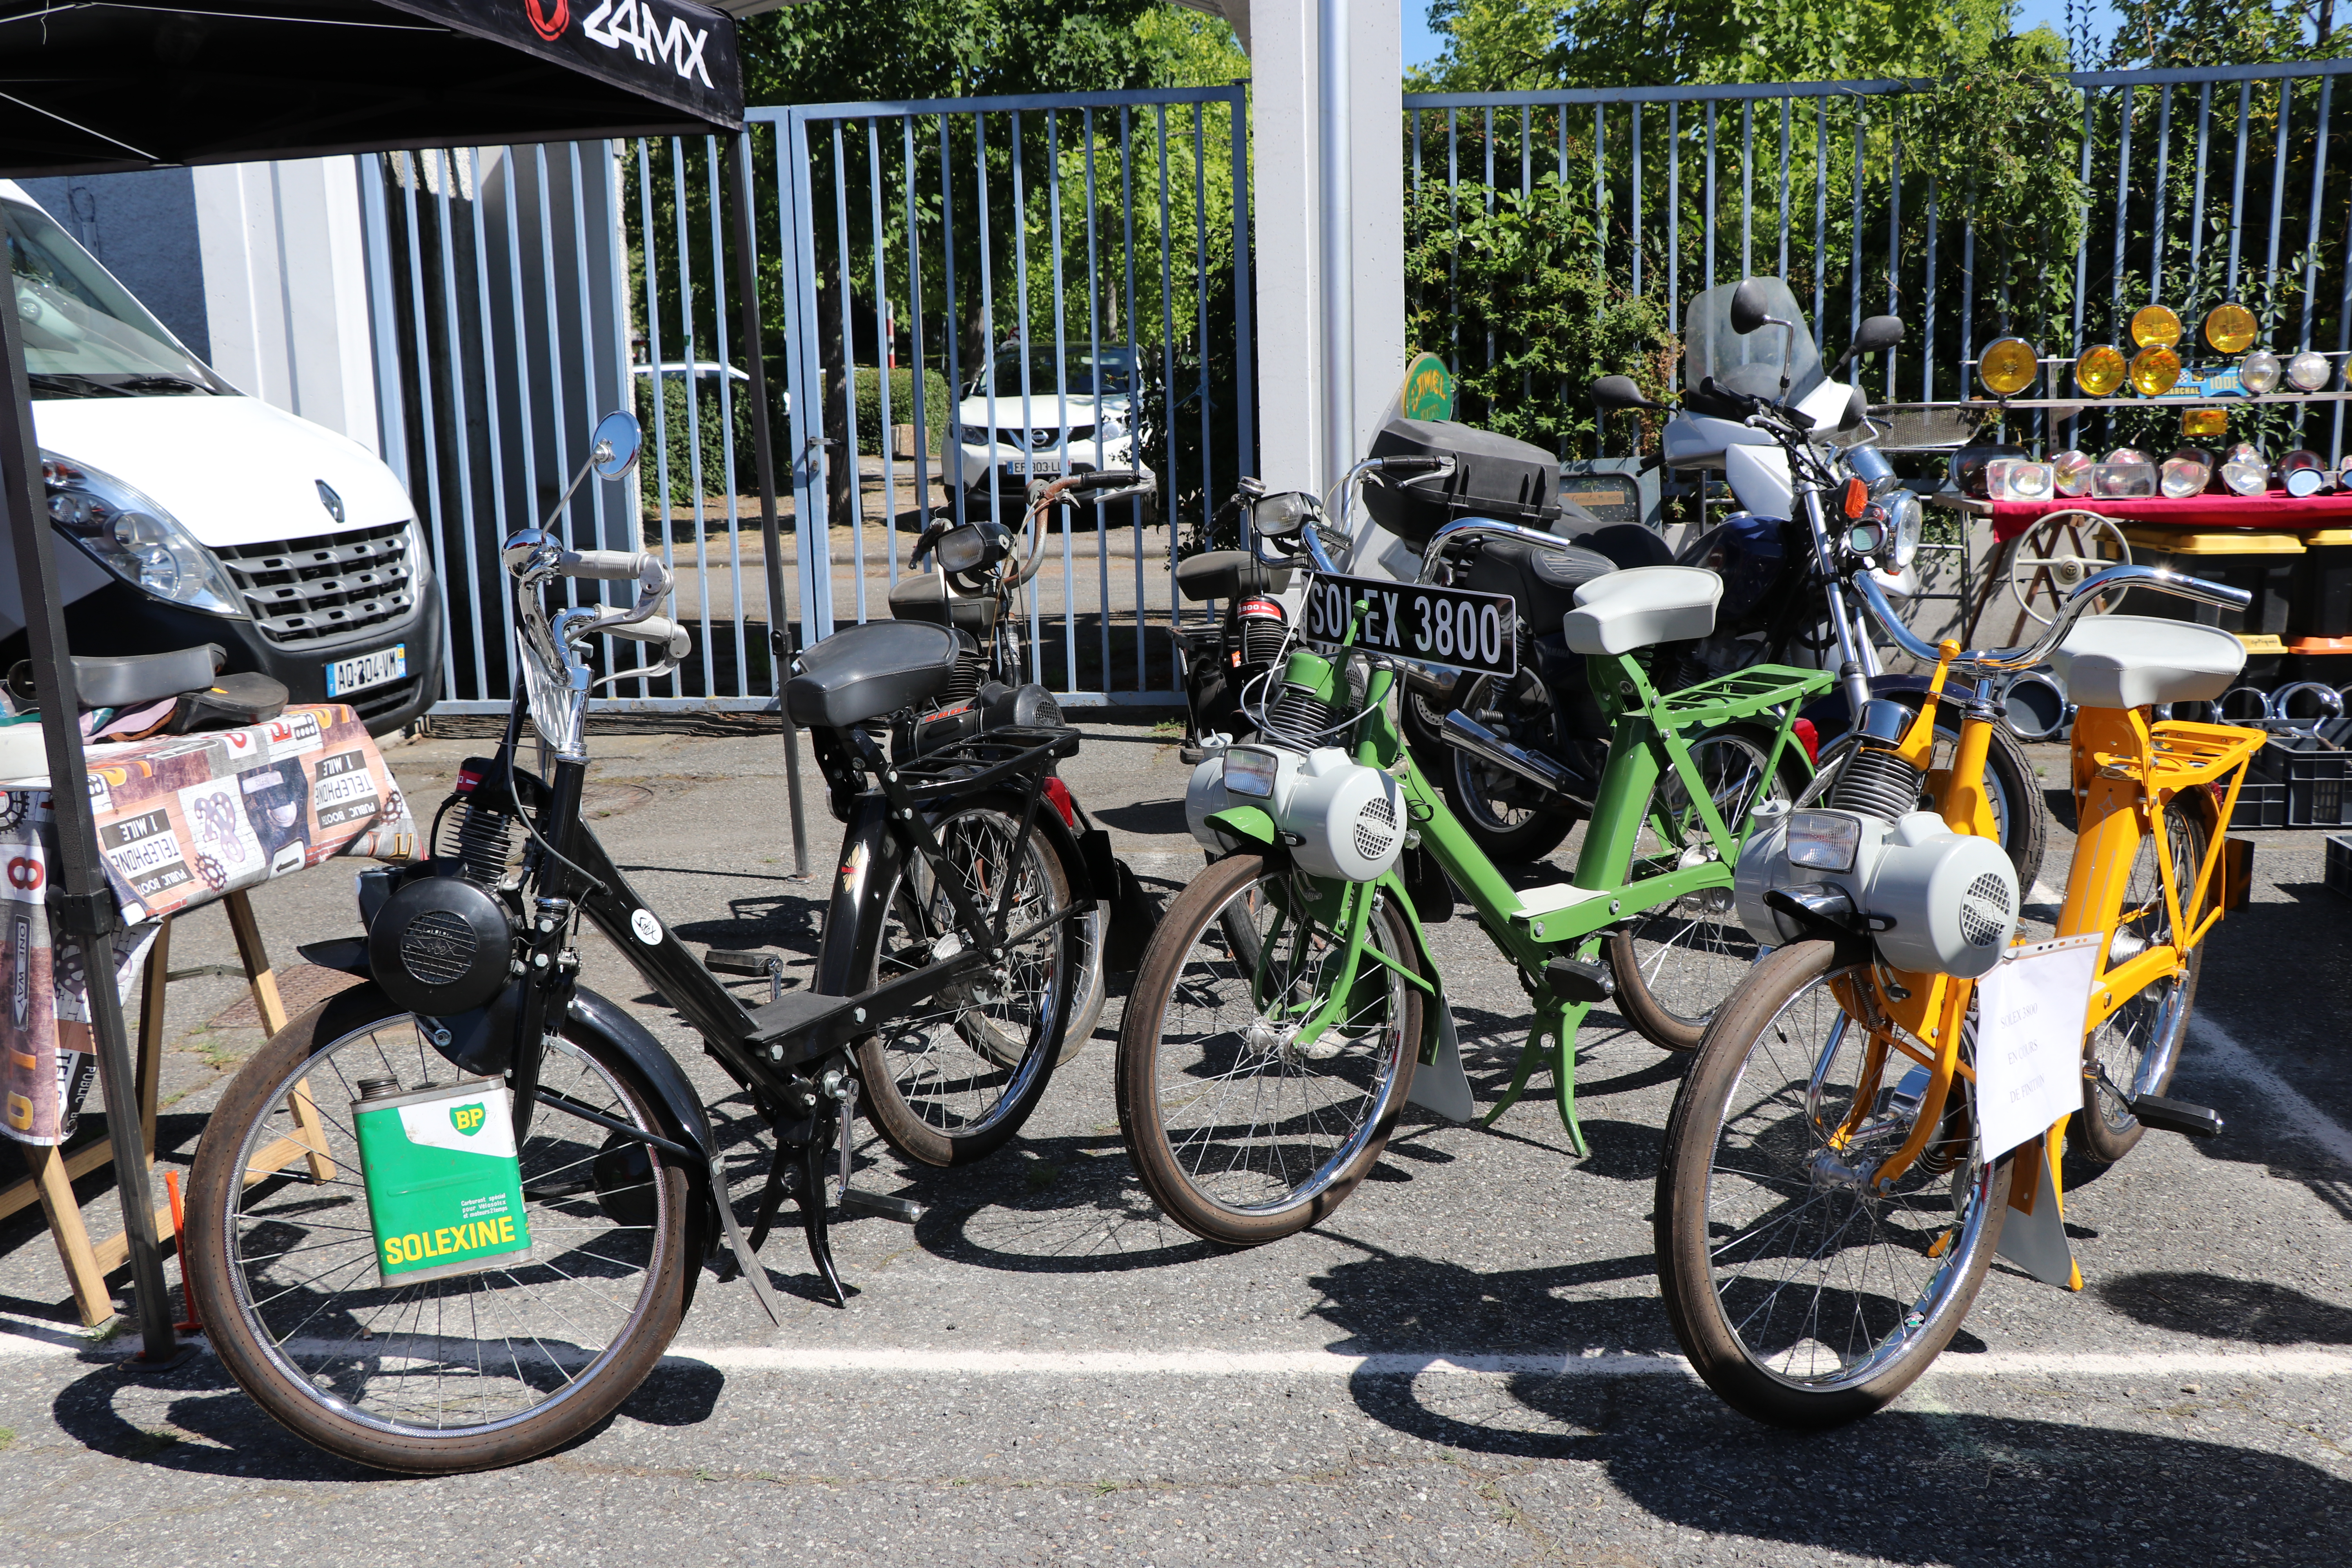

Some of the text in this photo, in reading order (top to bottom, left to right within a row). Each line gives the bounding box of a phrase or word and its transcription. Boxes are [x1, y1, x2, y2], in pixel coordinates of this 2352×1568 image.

[583, 0, 715, 89] 24MX
[1412, 369, 1447, 412] CAMEL
[2210, 376, 2239, 390] IODE
[1310, 581, 1502, 664] SOLEX 3800
[323, 757, 343, 777] MILE
[316, 774, 373, 805] TELEPHONE
[348, 802, 376, 817] PUBLIC
[119, 818, 148, 841] MILE
[161, 869, 188, 886] PUBLIC
[633, 917, 658, 942] Solex
[2001, 1002, 2038, 1029] SOLEX 3800
[2008, 1039, 2038, 1065] EN COURS
[76, 1066, 97, 1103] PUBLIC
[2009, 1073, 2045, 1103] DE FINITION
[454, 1108, 484, 1130] BP
[461, 1192, 506, 1206] Carburant spécial
[478, 1200, 506, 1209] Vélosolex
[470, 1209, 490, 1218] moteurs
[384, 1216, 516, 1265] SOLEXINE
